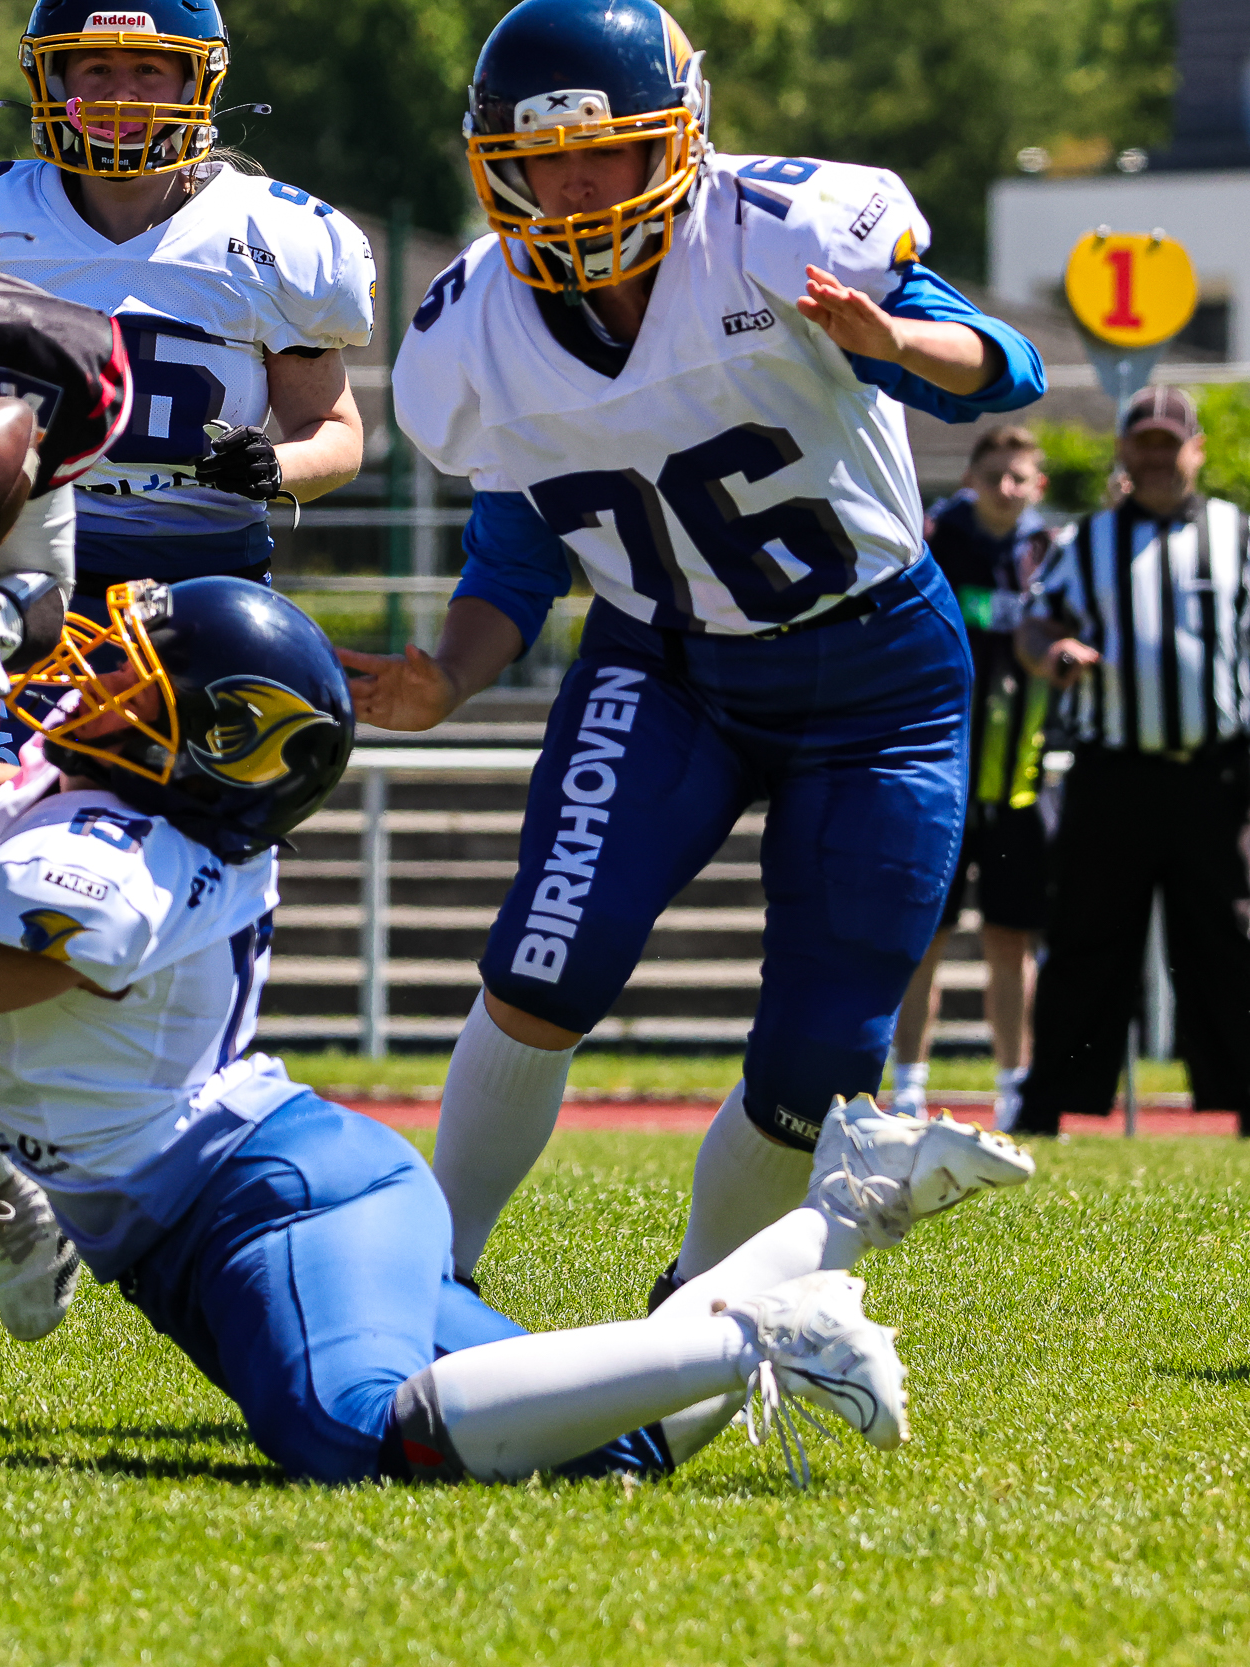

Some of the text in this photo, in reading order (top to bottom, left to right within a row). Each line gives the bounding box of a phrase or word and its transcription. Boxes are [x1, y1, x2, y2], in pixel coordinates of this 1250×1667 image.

[92, 15, 146, 26] Riddell
[101, 156, 130, 166] Ridell
[852, 193, 888, 240] TNKD
[1101, 249, 1144, 329] 1
[528, 421, 857, 635] 76
[510, 665, 648, 985] BIRKHOVEN
[47, 870, 109, 901] TNKD
